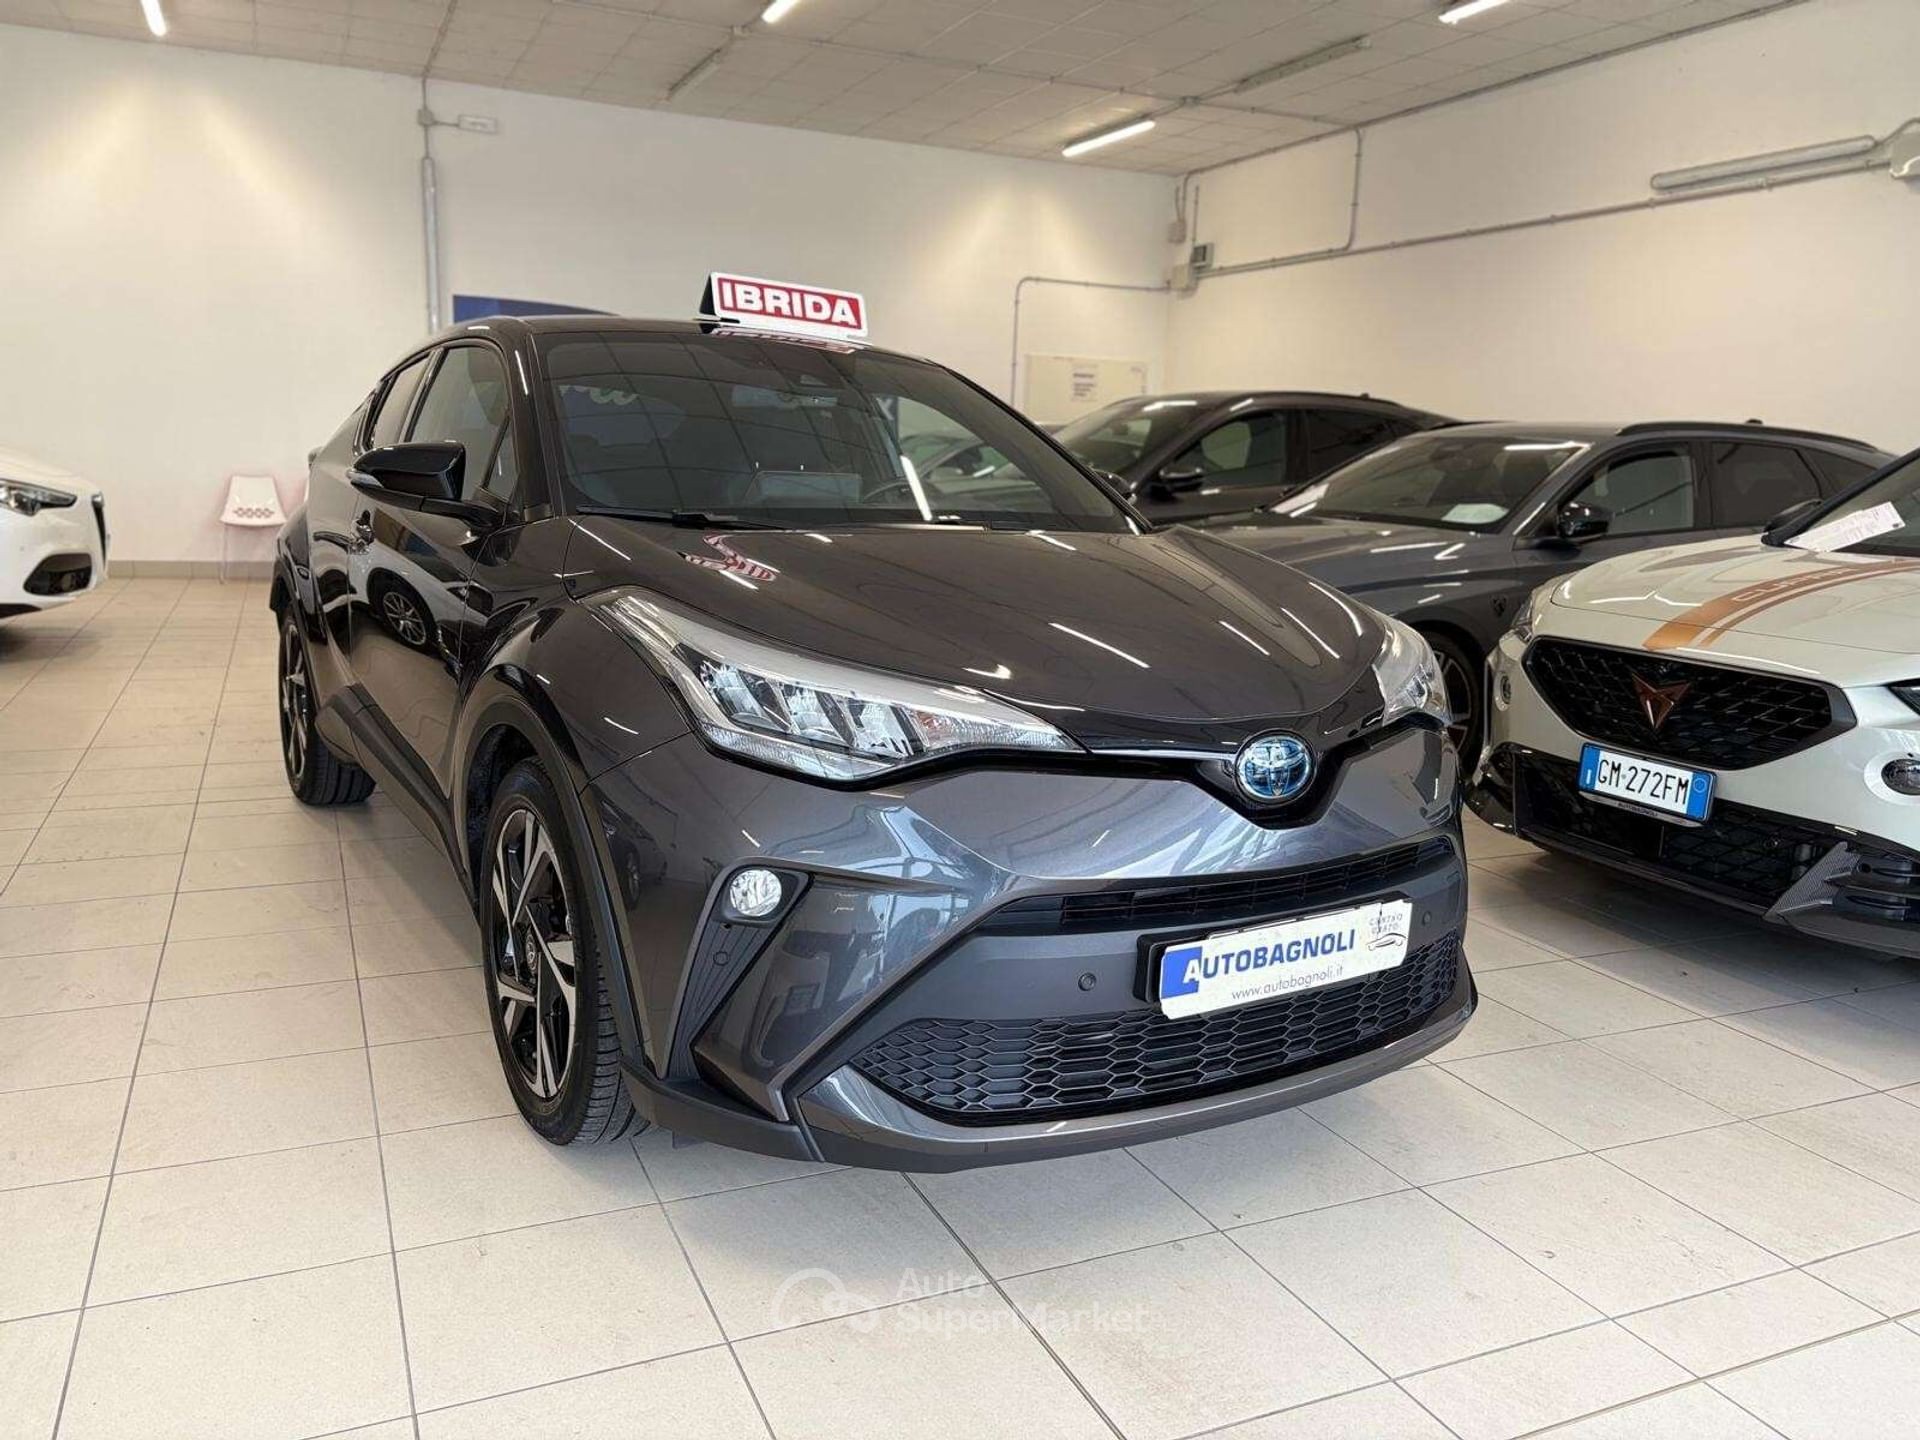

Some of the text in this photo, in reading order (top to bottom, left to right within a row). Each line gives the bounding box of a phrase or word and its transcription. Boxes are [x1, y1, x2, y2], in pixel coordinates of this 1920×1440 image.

[721, 281, 858, 328] IBRIDA
[1182, 929, 1356, 984] AUTOBAGNOLI
[1231, 964, 1344, 1000] www.autobagnoli.it
